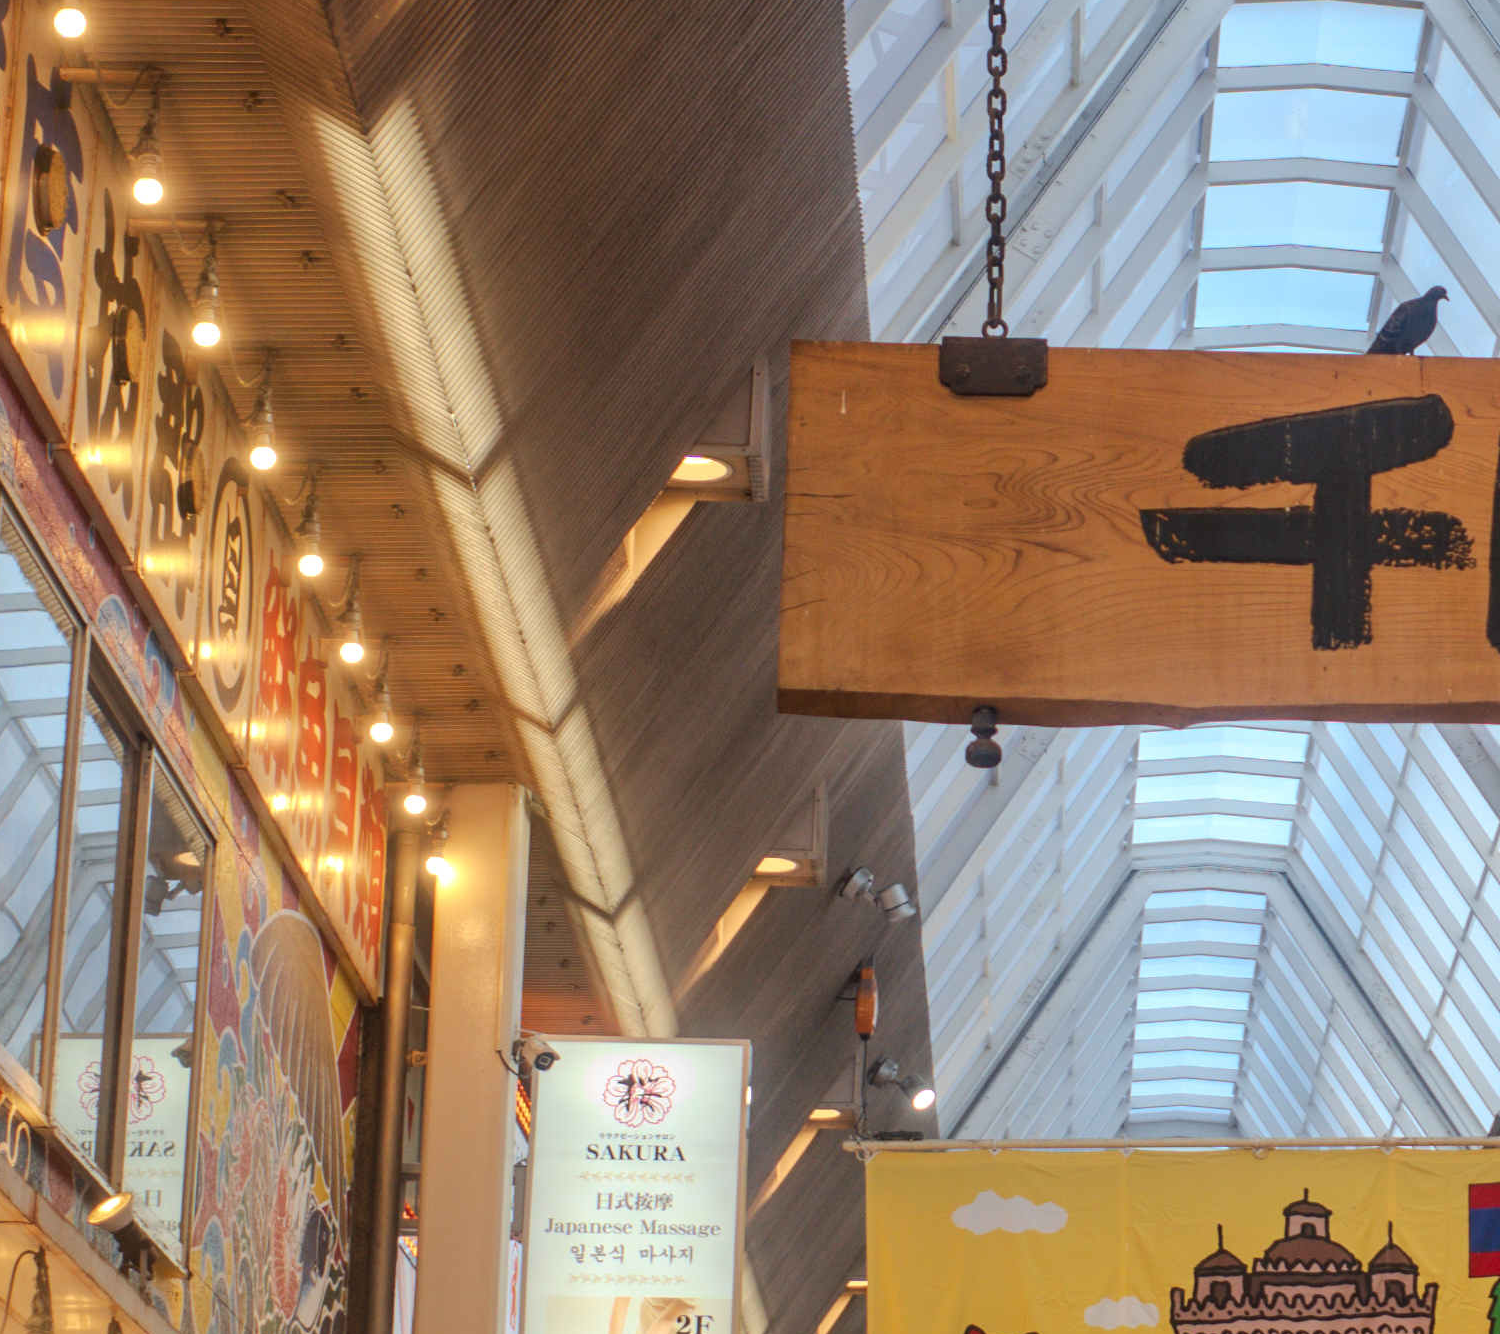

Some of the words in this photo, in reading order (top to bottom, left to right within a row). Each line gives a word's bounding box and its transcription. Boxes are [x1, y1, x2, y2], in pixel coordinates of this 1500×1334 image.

[586, 1144, 686, 1162] SAKURA
[596, 1192, 674, 1211] 日式按摩
[545, 1218, 633, 1236] Japanese
[640, 1219, 721, 1238] Massage
[570, 1243, 626, 1264] 일본식
[639, 1244, 694, 1265] 마사지
